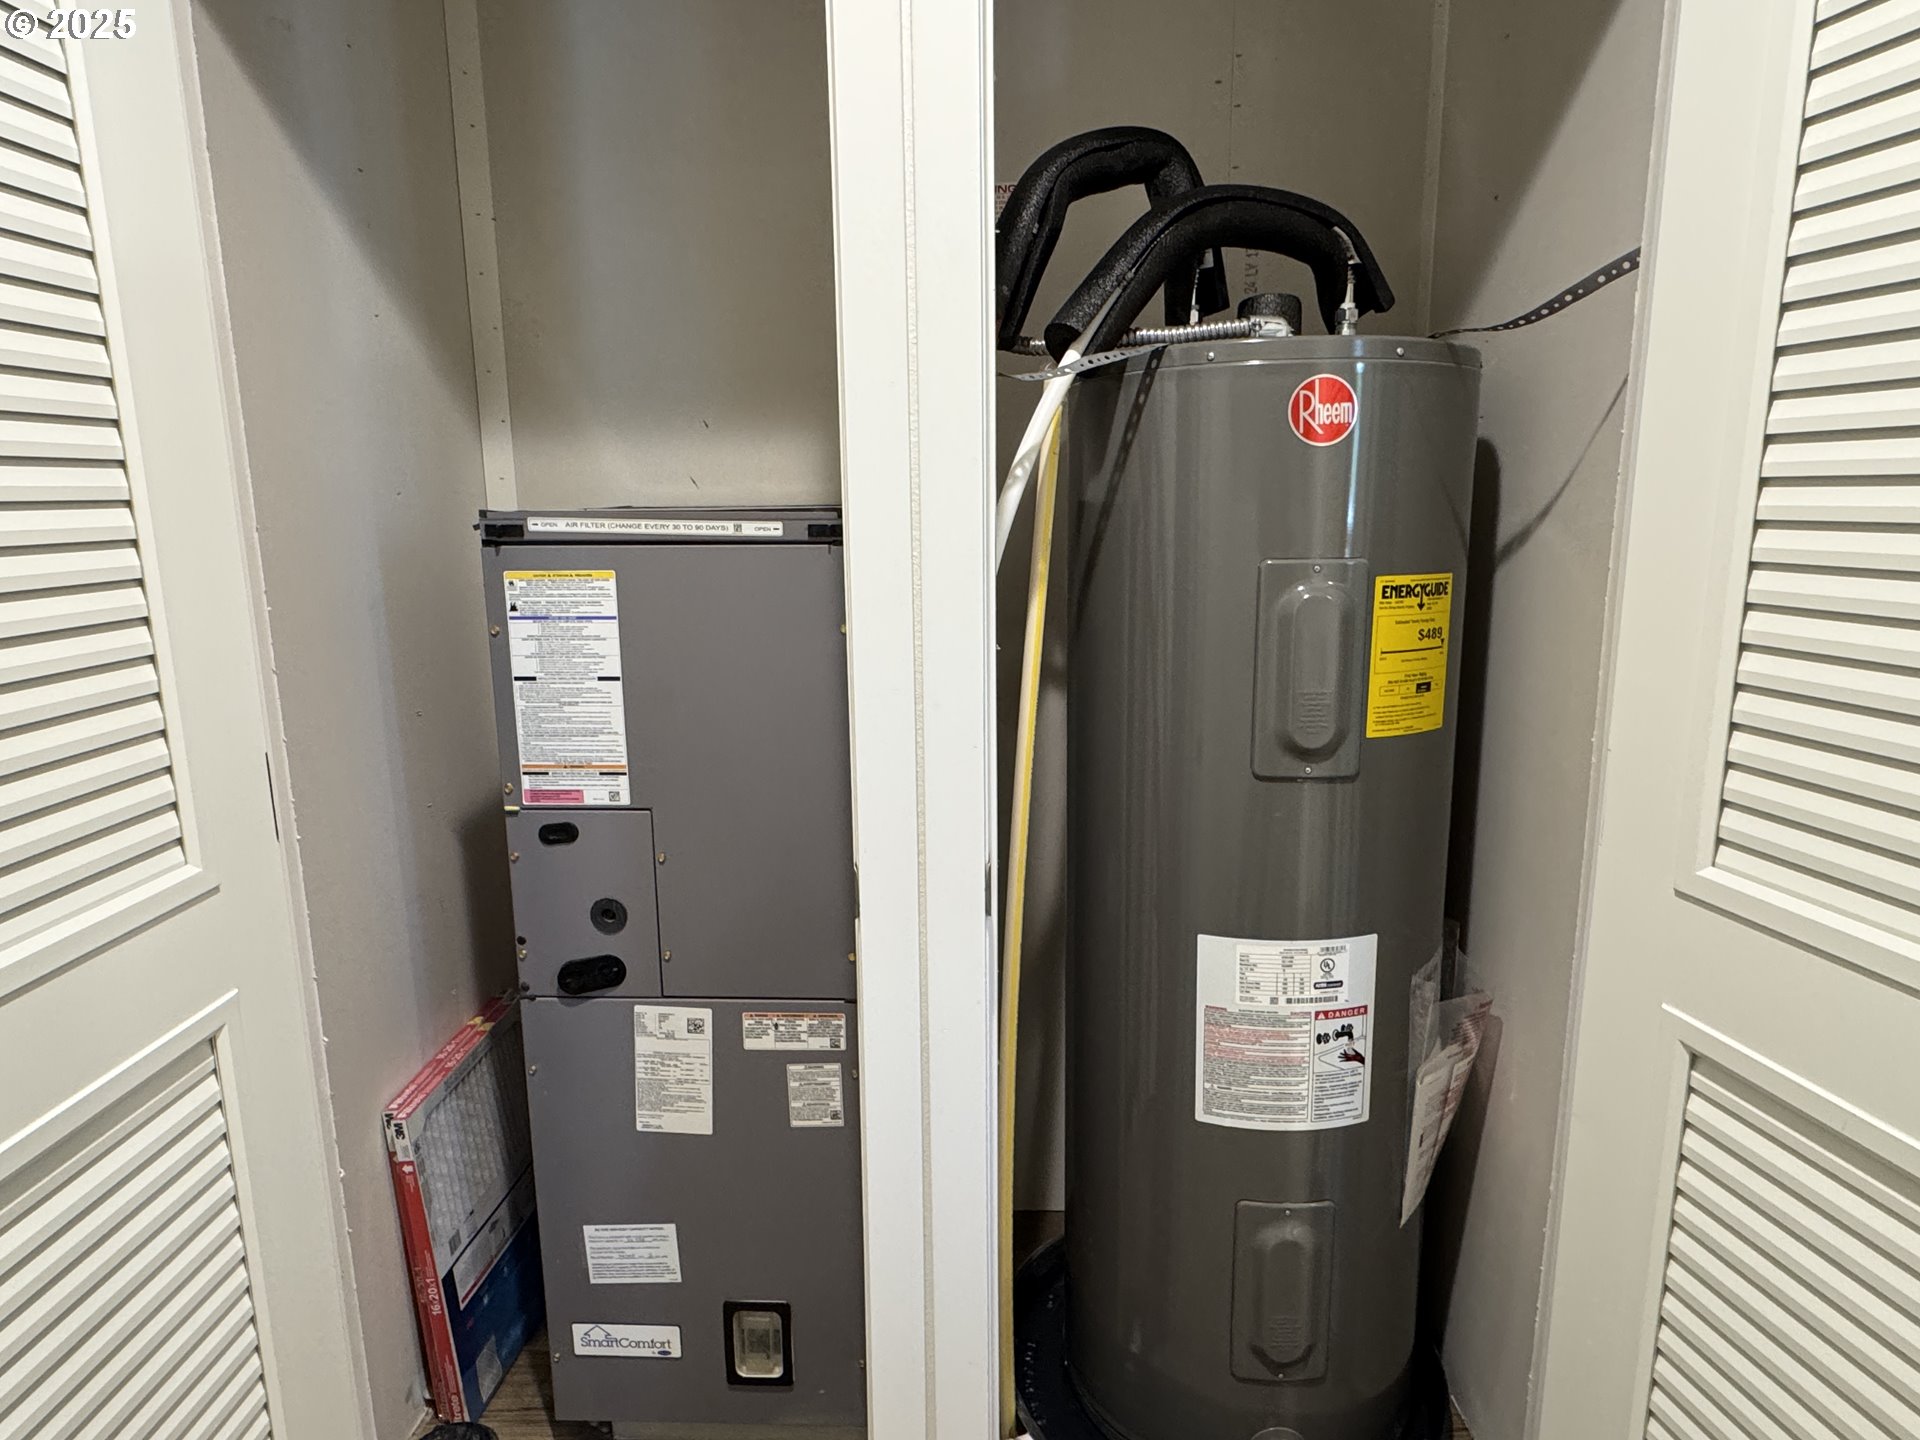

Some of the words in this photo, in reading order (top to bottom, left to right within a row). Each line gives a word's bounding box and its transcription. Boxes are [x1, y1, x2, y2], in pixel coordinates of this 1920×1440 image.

[1299, 378, 1353, 434] Rheem
[608, 522, 642, 530] (CHANGE
[1382, 581, 1449, 600] ENERGYGUIDE
[1328, 1008, 1365, 1018] DANGER
[393, 1123, 405, 1140] 3M
[581, 1337, 672, 1349] SmartComfort
